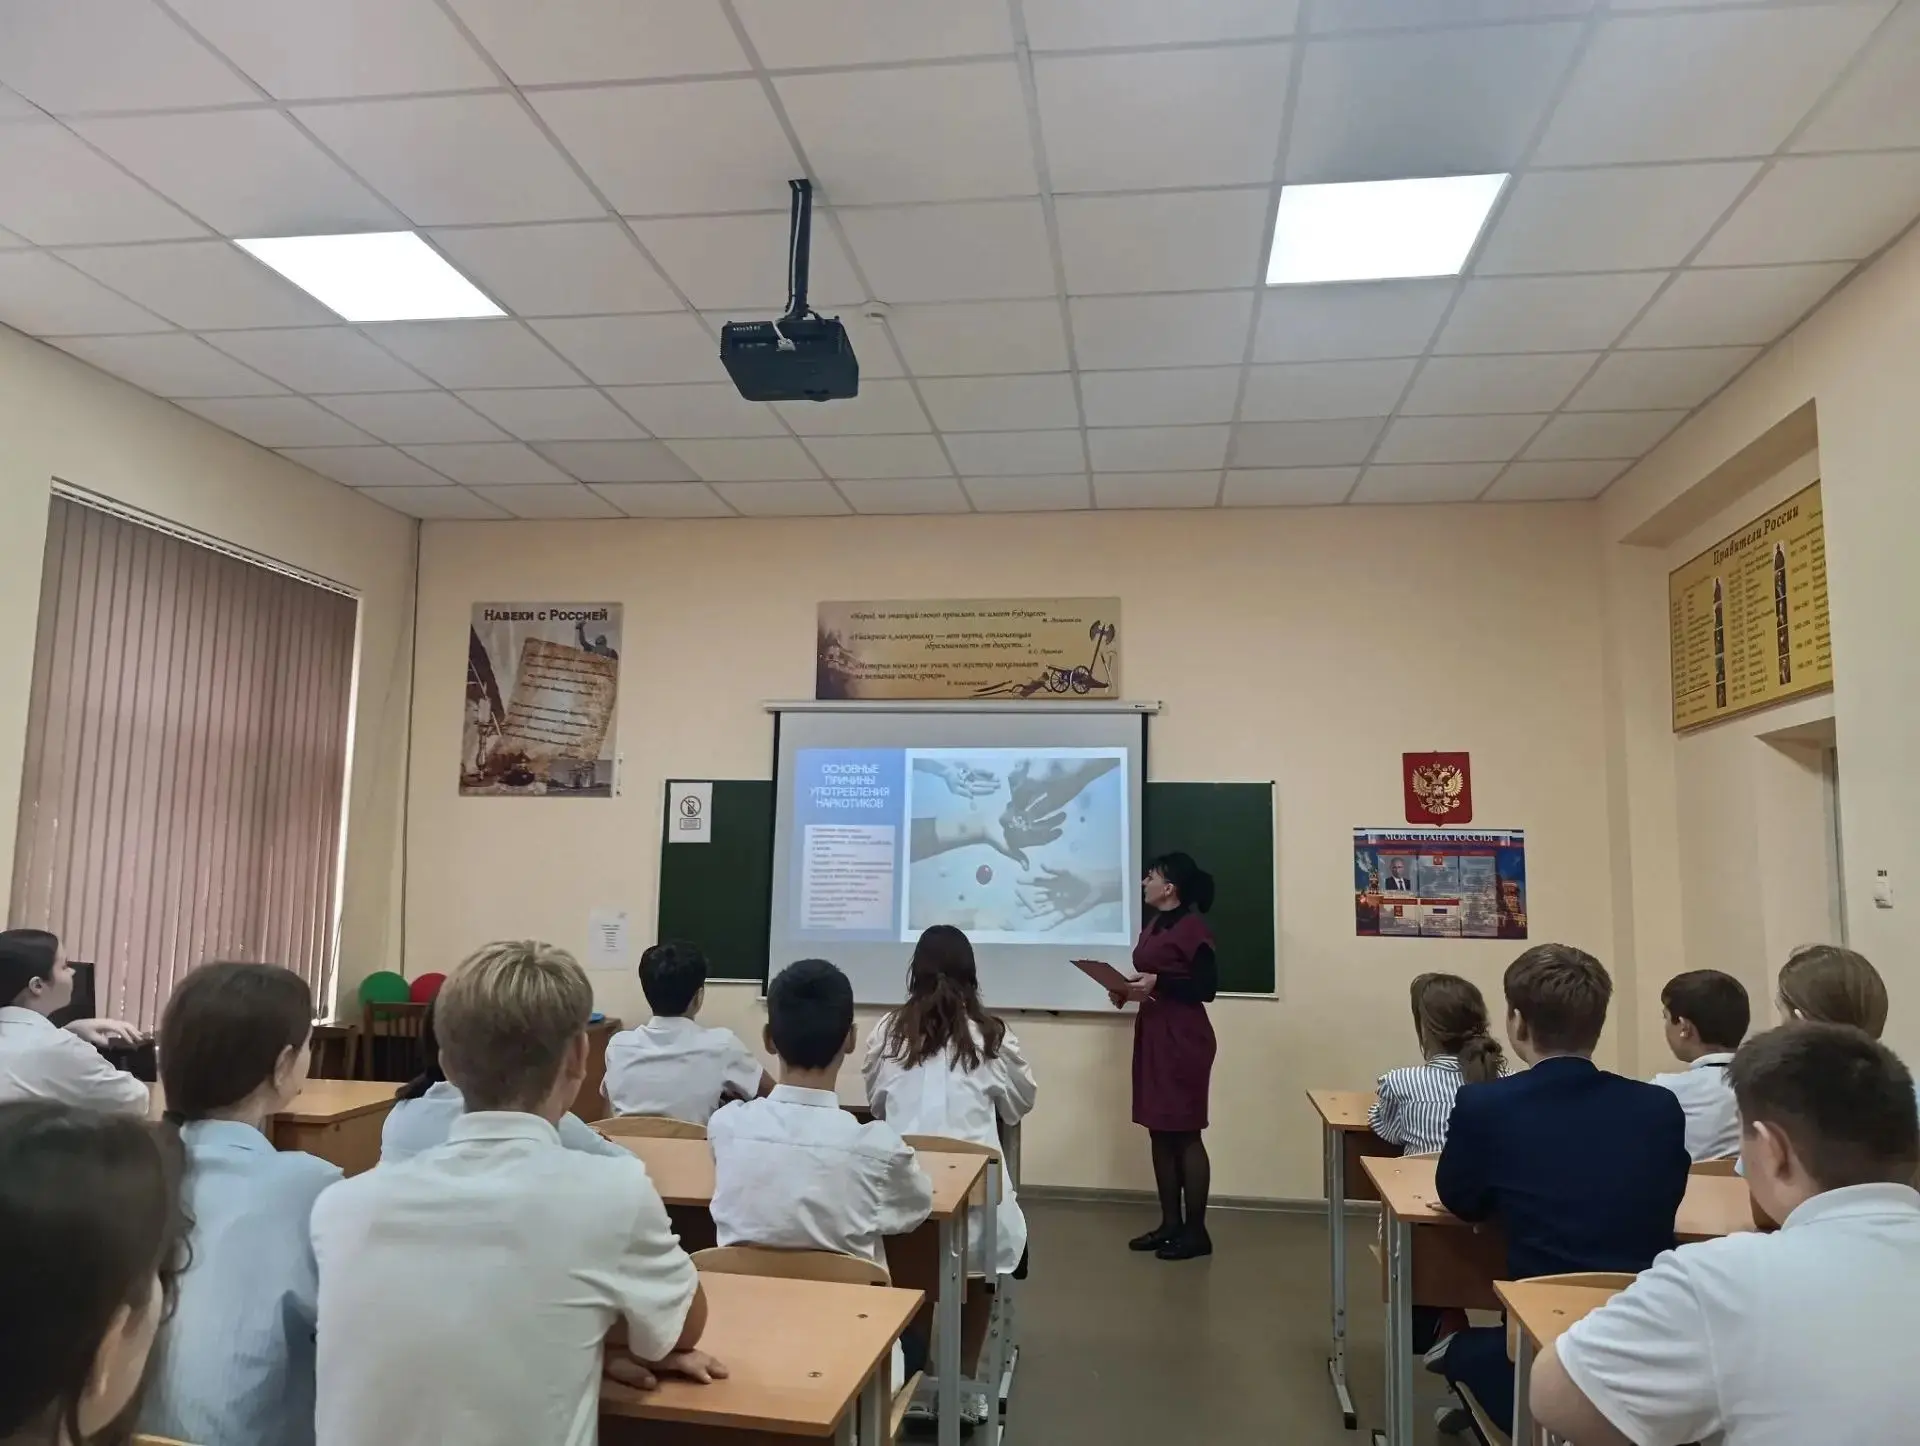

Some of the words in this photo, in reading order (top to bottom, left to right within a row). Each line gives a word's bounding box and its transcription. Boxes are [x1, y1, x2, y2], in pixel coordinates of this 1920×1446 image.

[1763, 505, 1799, 535] России
[821, 764, 880, 774] ОСНОВНЫЕ
[825, 775, 876, 785] ПРИЧИНЫ
[808, 786, 890, 797] УПОТРЕБЛЕНИЯ
[815, 797, 885, 808] НАРКОТИКОВ
[1384, 833, 1407, 841] МОЯ
[1410, 833, 1450, 841] СТРАНА
[1453, 834, 1494, 842] РОССИЯ
